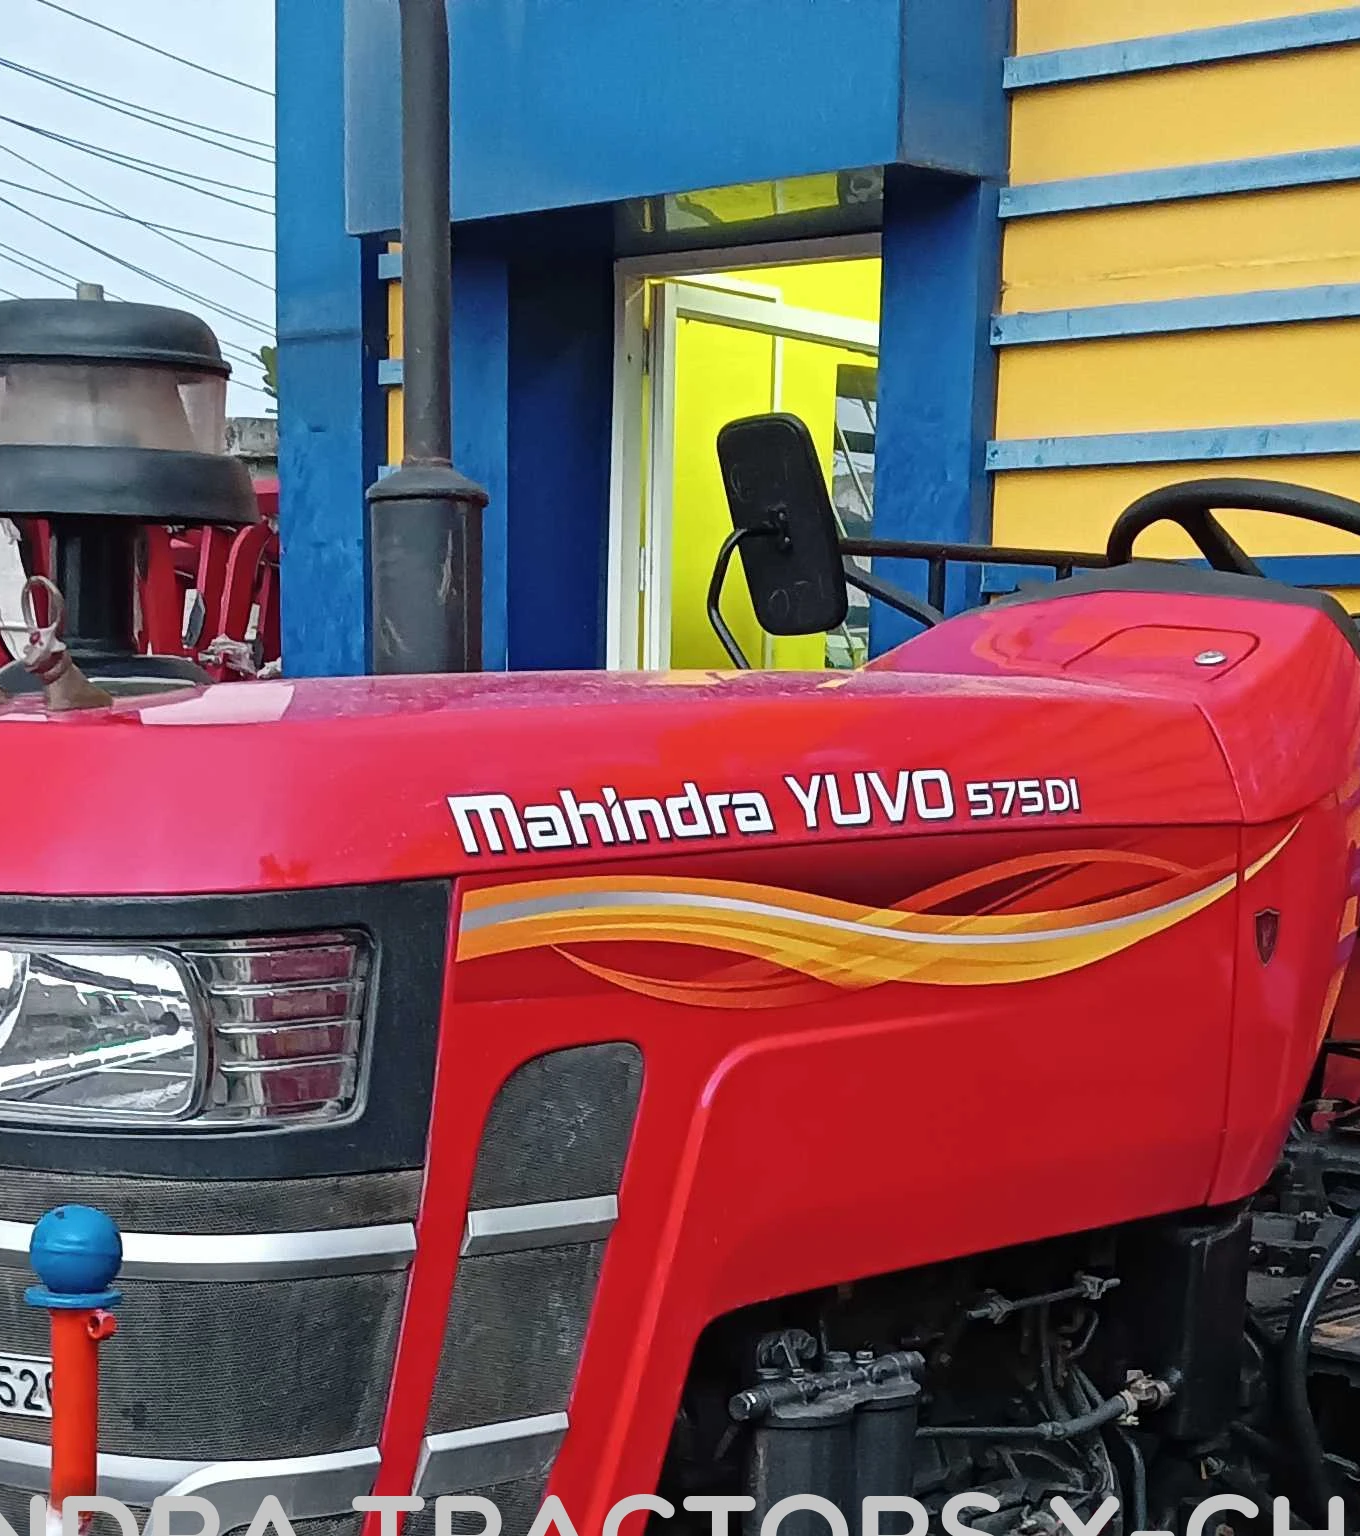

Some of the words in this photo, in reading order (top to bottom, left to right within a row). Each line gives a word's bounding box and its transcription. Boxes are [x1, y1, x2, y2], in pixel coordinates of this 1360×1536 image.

[446, 780, 775, 854] Mahindra
[783, 768, 956, 829] YUVO
[965, 777, 1081, 818] 575DI
